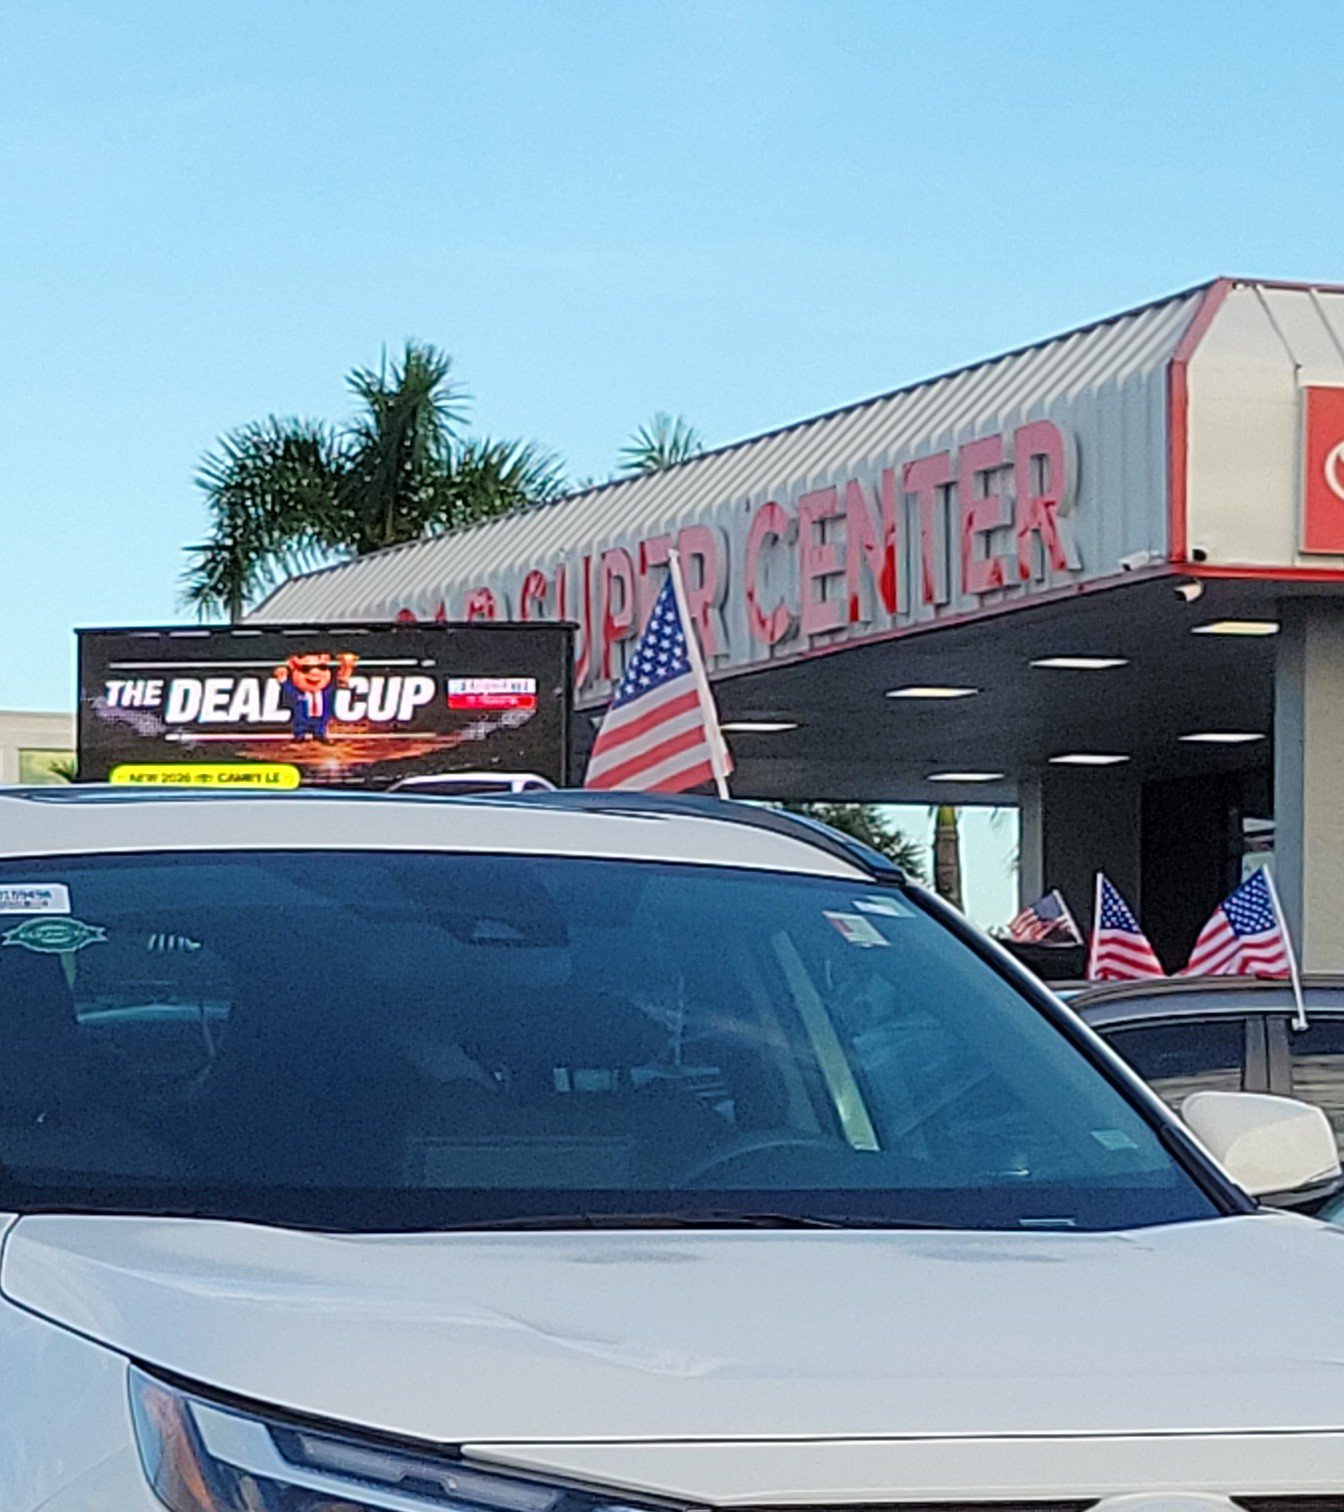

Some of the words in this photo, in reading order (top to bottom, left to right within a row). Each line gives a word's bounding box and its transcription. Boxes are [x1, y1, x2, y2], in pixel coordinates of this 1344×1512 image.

[744, 416, 1080, 647] CENTER
[105, 679, 164, 708] THE
[165, 677, 292, 724] DEAL
[334, 676, 436, 723] CUP
